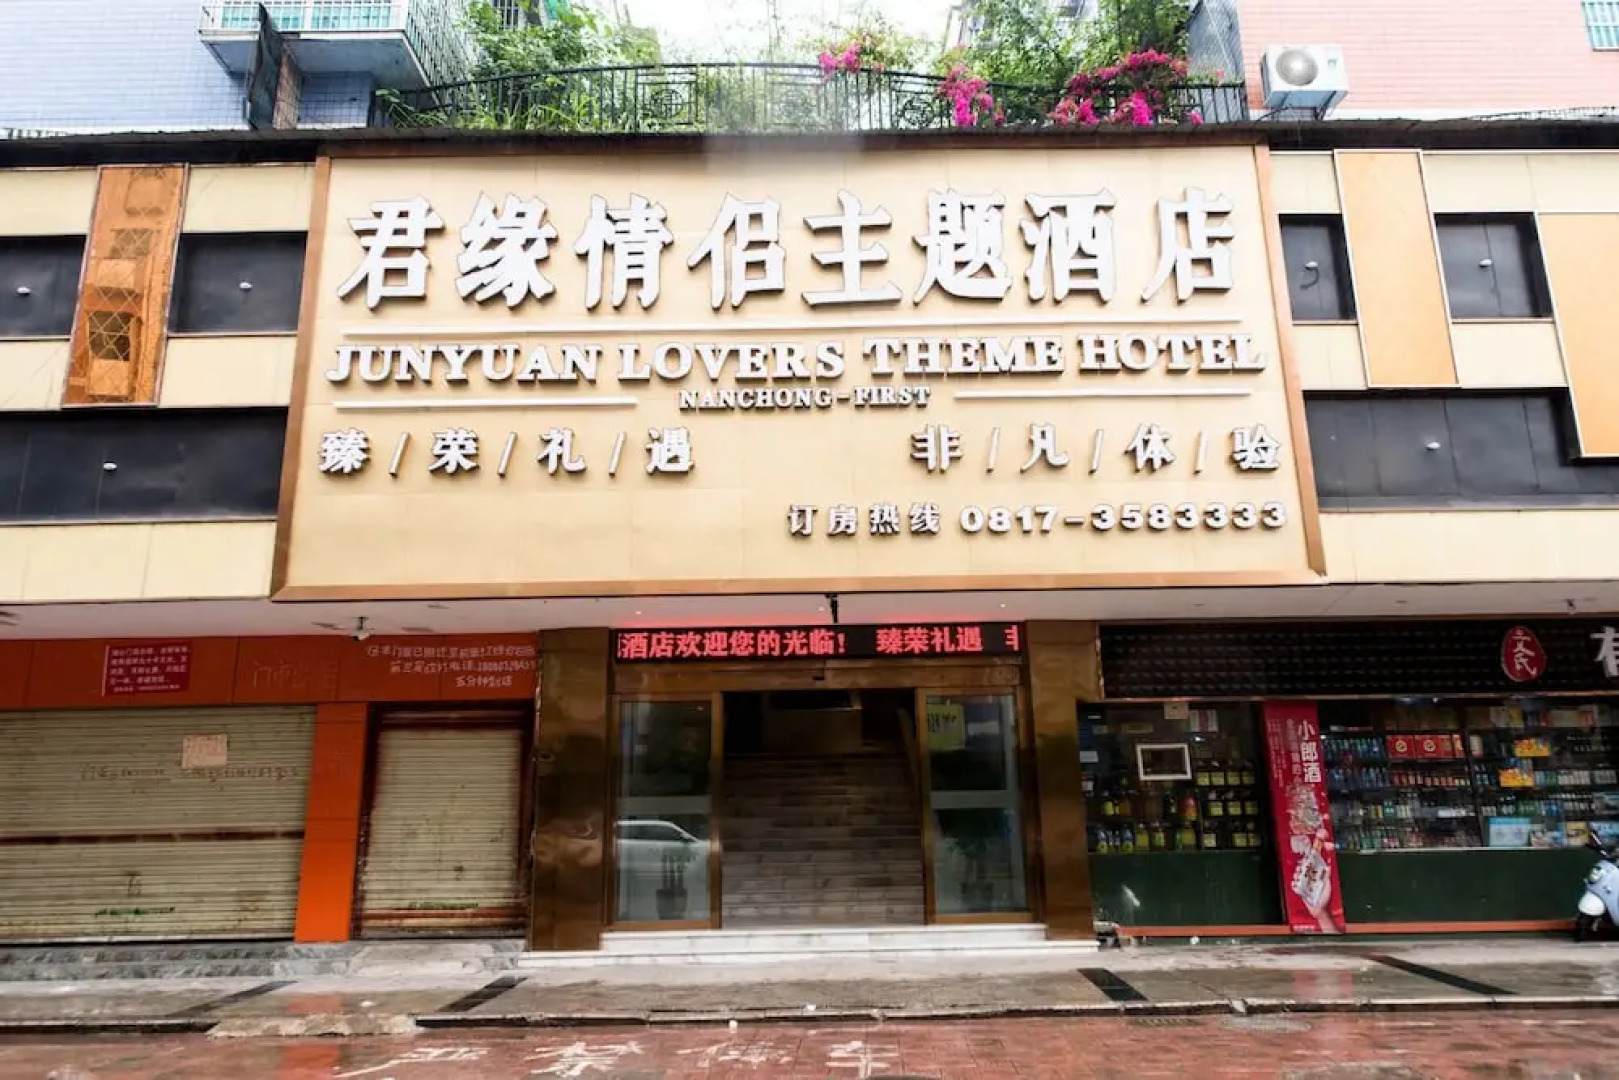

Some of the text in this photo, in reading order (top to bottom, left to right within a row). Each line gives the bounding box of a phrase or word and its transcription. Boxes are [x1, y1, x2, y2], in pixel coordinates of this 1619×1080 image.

[337, 187, 1236, 310] 君缘情侣主题酒店
[325, 332, 1265, 384] JUNYUAN LOVERS THEME HOTEL
[679, 386, 931, 411] NANCHONG-FIRST
[787, 501, 1288, 536] 订房热线 0817-3583333
[875, 626, 984, 654] 臻荣礼遇
[1297, 718, 1322, 783] 小郎酒
